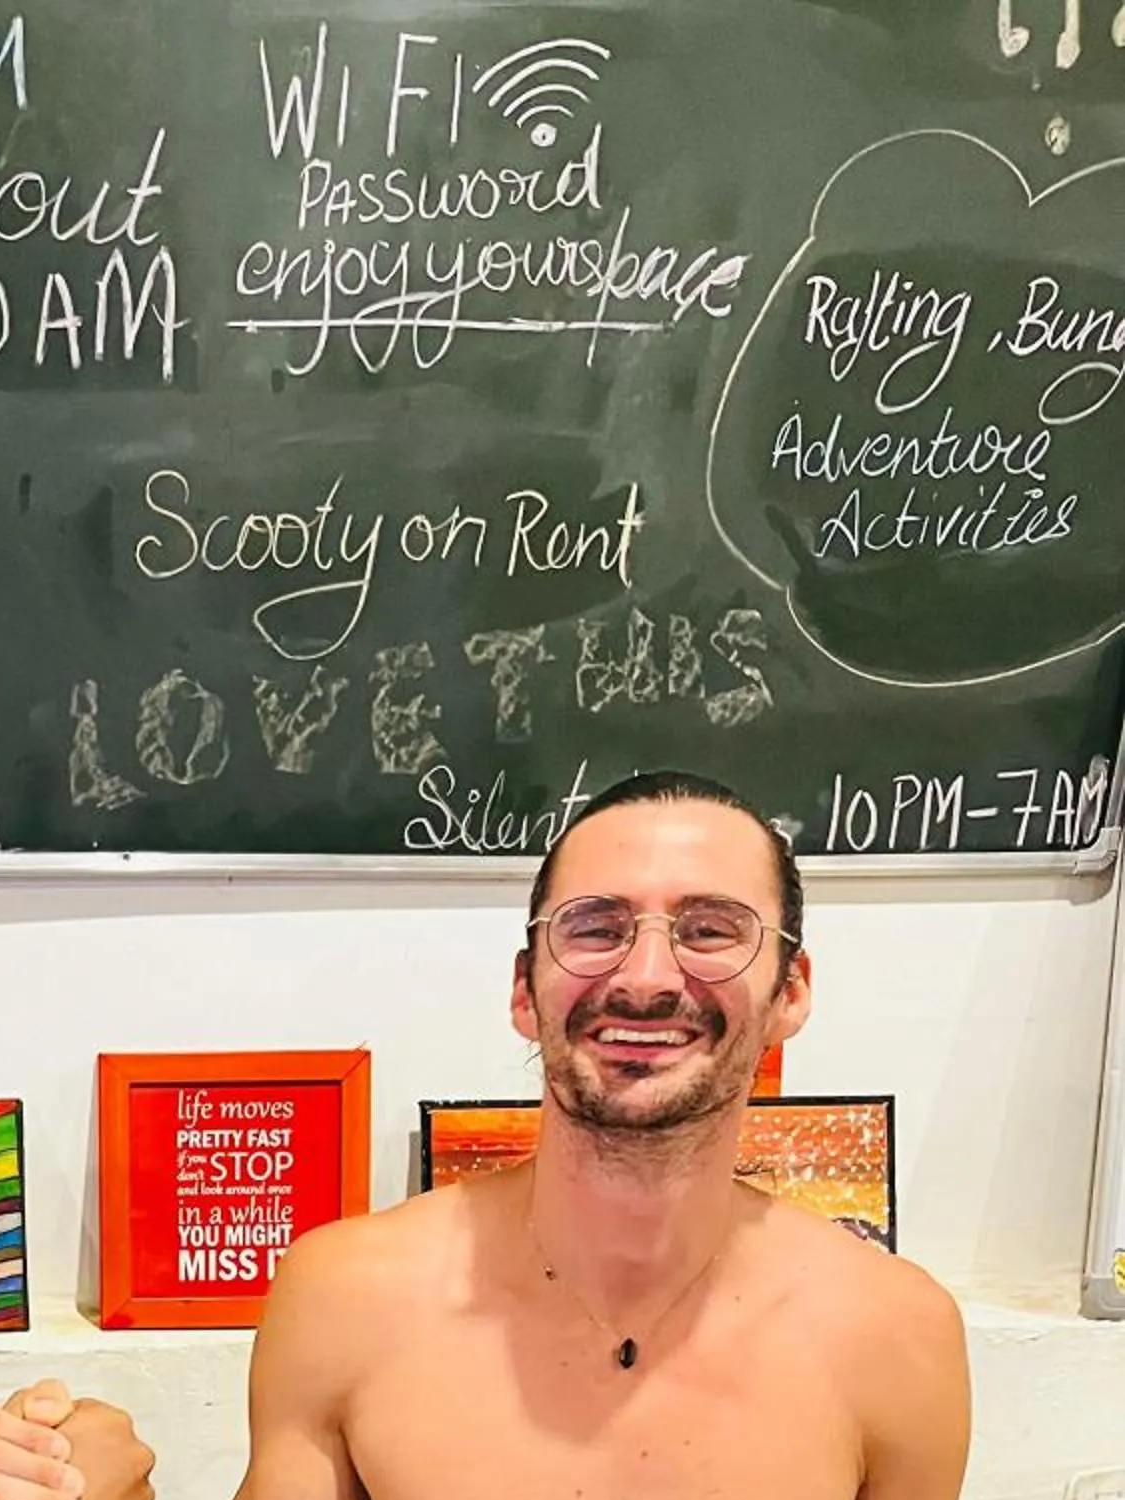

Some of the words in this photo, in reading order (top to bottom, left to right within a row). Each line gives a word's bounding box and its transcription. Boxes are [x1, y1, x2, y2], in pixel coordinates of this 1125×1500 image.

[135, 469, 384, 661] Scooty
[400, 503, 488, 566] on
[505, 481, 646, 590] Rent
[176, 1089, 214, 1129] life
[220, 1100, 295, 1119] moves
[176, 1129, 243, 1149] PRETTY
[246, 1128, 294, 1148] FAST
[209, 1150, 295, 1182] STOP
[177, 1199, 203, 1226] in
[209, 1206, 224, 1226] a
[228, 1194, 295, 1225] while
[177, 1224, 221, 1247] YOU
[225, 1223, 294, 1246] MIGHT
[178, 1249, 259, 1282] MISS
